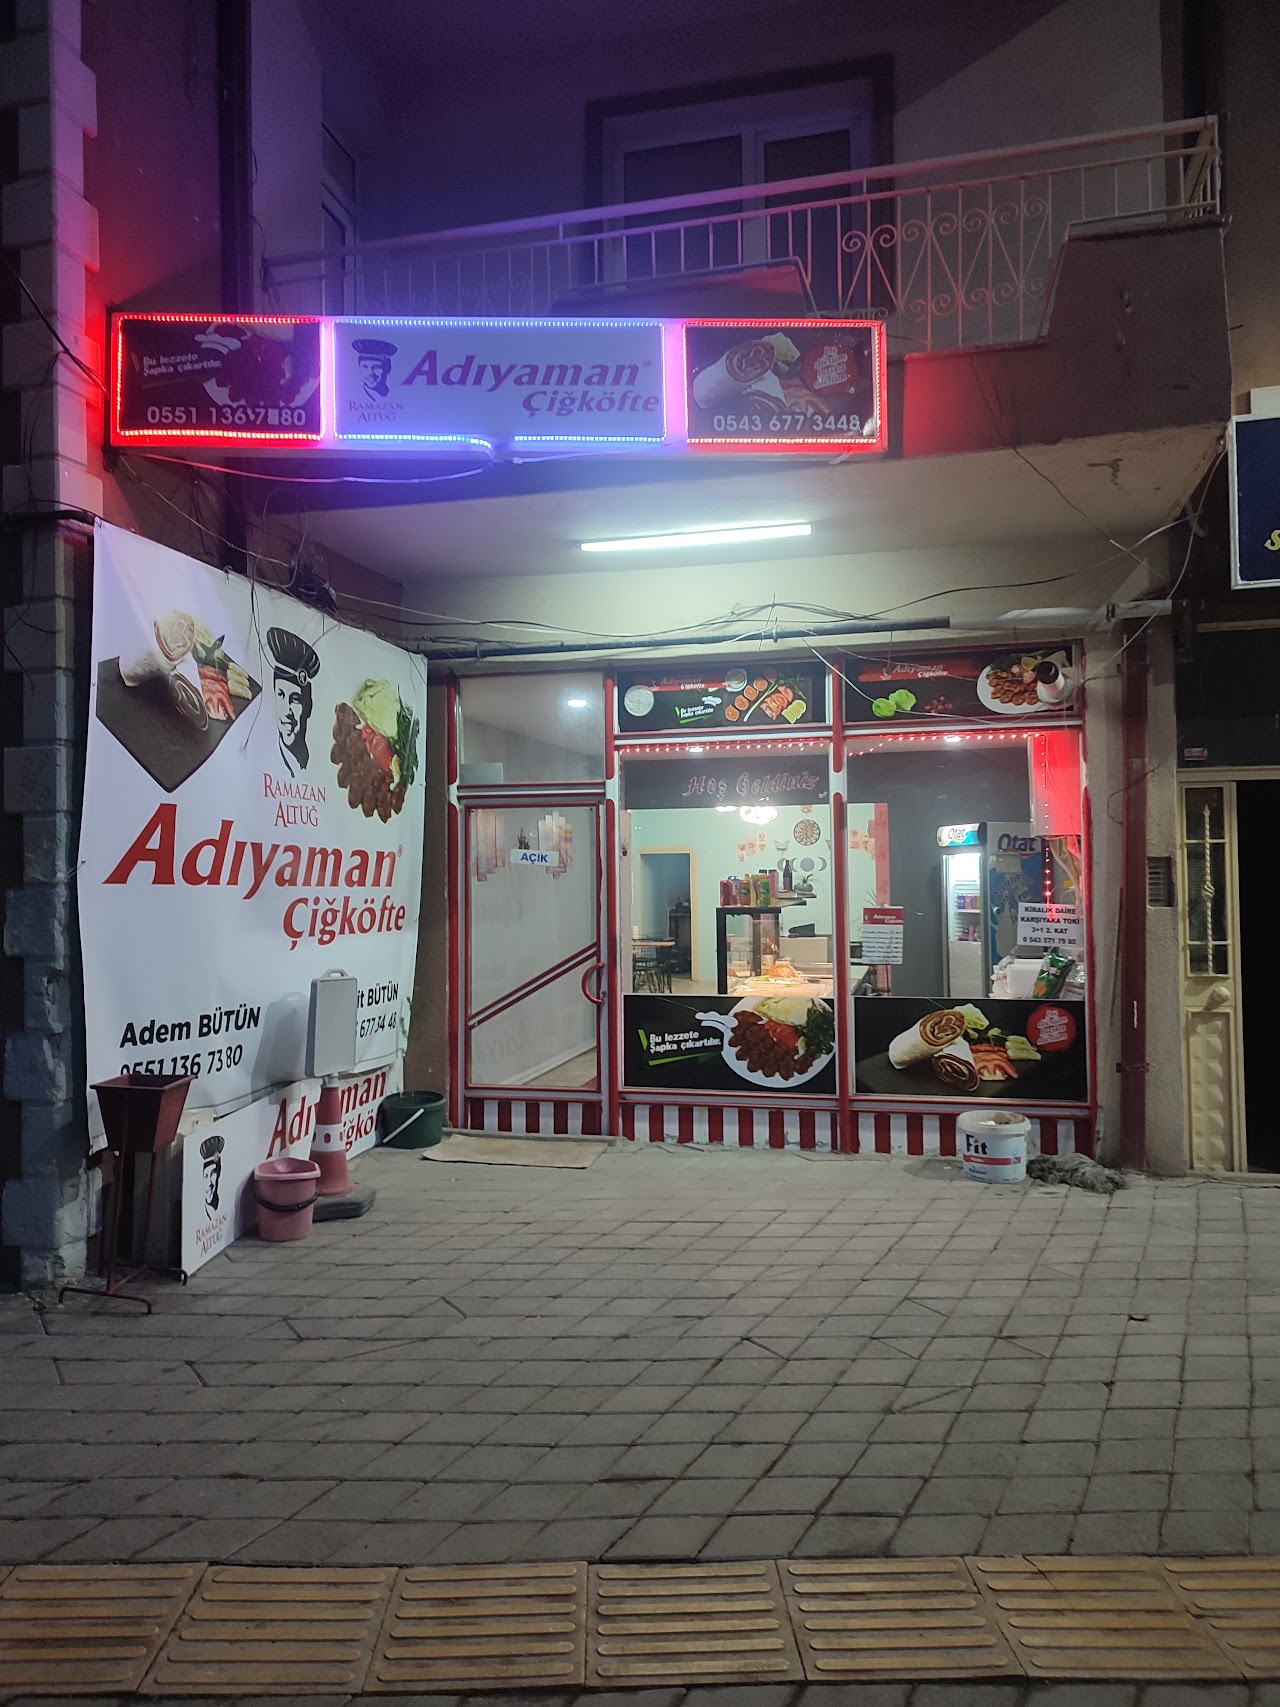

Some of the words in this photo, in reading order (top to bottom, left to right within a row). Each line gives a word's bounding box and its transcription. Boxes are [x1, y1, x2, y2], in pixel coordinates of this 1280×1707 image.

[400, 350, 640, 392] Adıyaman
[147, 406, 197, 424] 0551
[210, 407, 246, 425] 136
[256, 408, 306, 426] 780
[522, 390, 660, 418] Çiğköfte
[713, 415, 762, 431] 0543
[769, 415, 804, 431] 677
[812, 414, 860, 431] 3448
[263, 772, 326, 803] RAMAZAN
[274, 801, 319, 828] ALTUĞ
[102, 803, 397, 900] Adıyaman
[998, 833, 1037, 852] Otat
[521, 853, 549, 865] AÇIK
[1024, 905, 1053, 913] KİRALIK
[282, 895, 406, 951] Çiğköfte
[367, 980, 399, 1007] BÜTÜN
[120, 1020, 191, 1048] Adem
[198, 1003, 261, 1038] BÜTÜN
[650, 1034, 661, 1043] Bu
[665, 1031, 699, 1042] lezzete
[650, 1042, 677, 1054] Şapka
[171, 1054, 201, 1075] 136
[266, 1071, 387, 1160] Adıman
[966, 1134, 987, 1155] Fit
